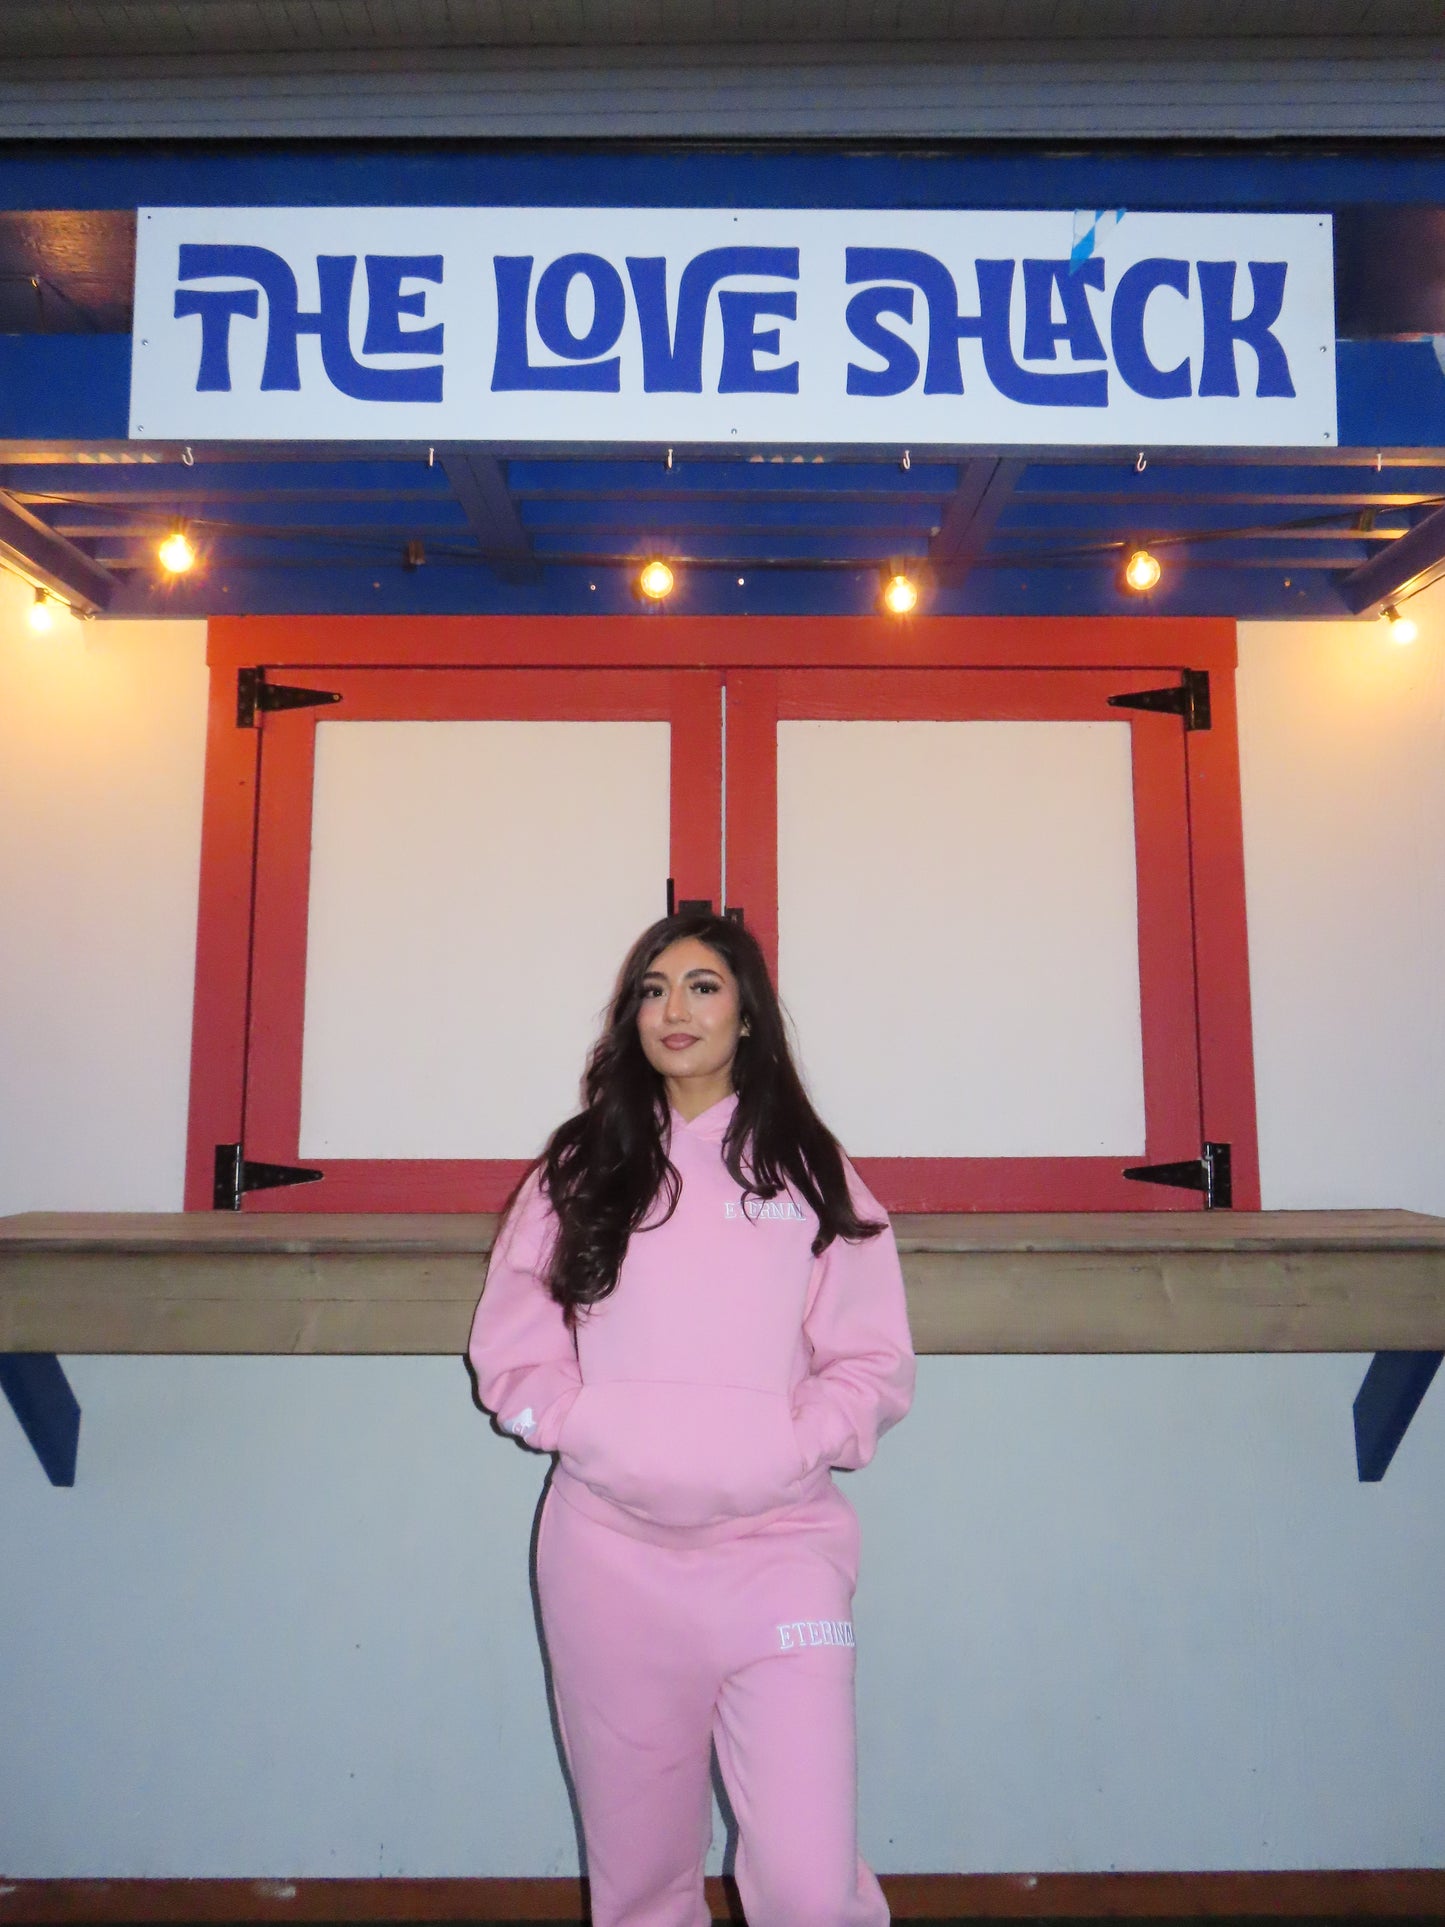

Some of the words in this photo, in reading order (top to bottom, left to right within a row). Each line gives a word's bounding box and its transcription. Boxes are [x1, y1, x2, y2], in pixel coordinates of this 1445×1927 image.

[174, 244, 444, 403] THE
[490, 246, 800, 394] LOVE
[845, 246, 1297, 408] SHACK
[777, 1620, 856, 1649] ETERNA
